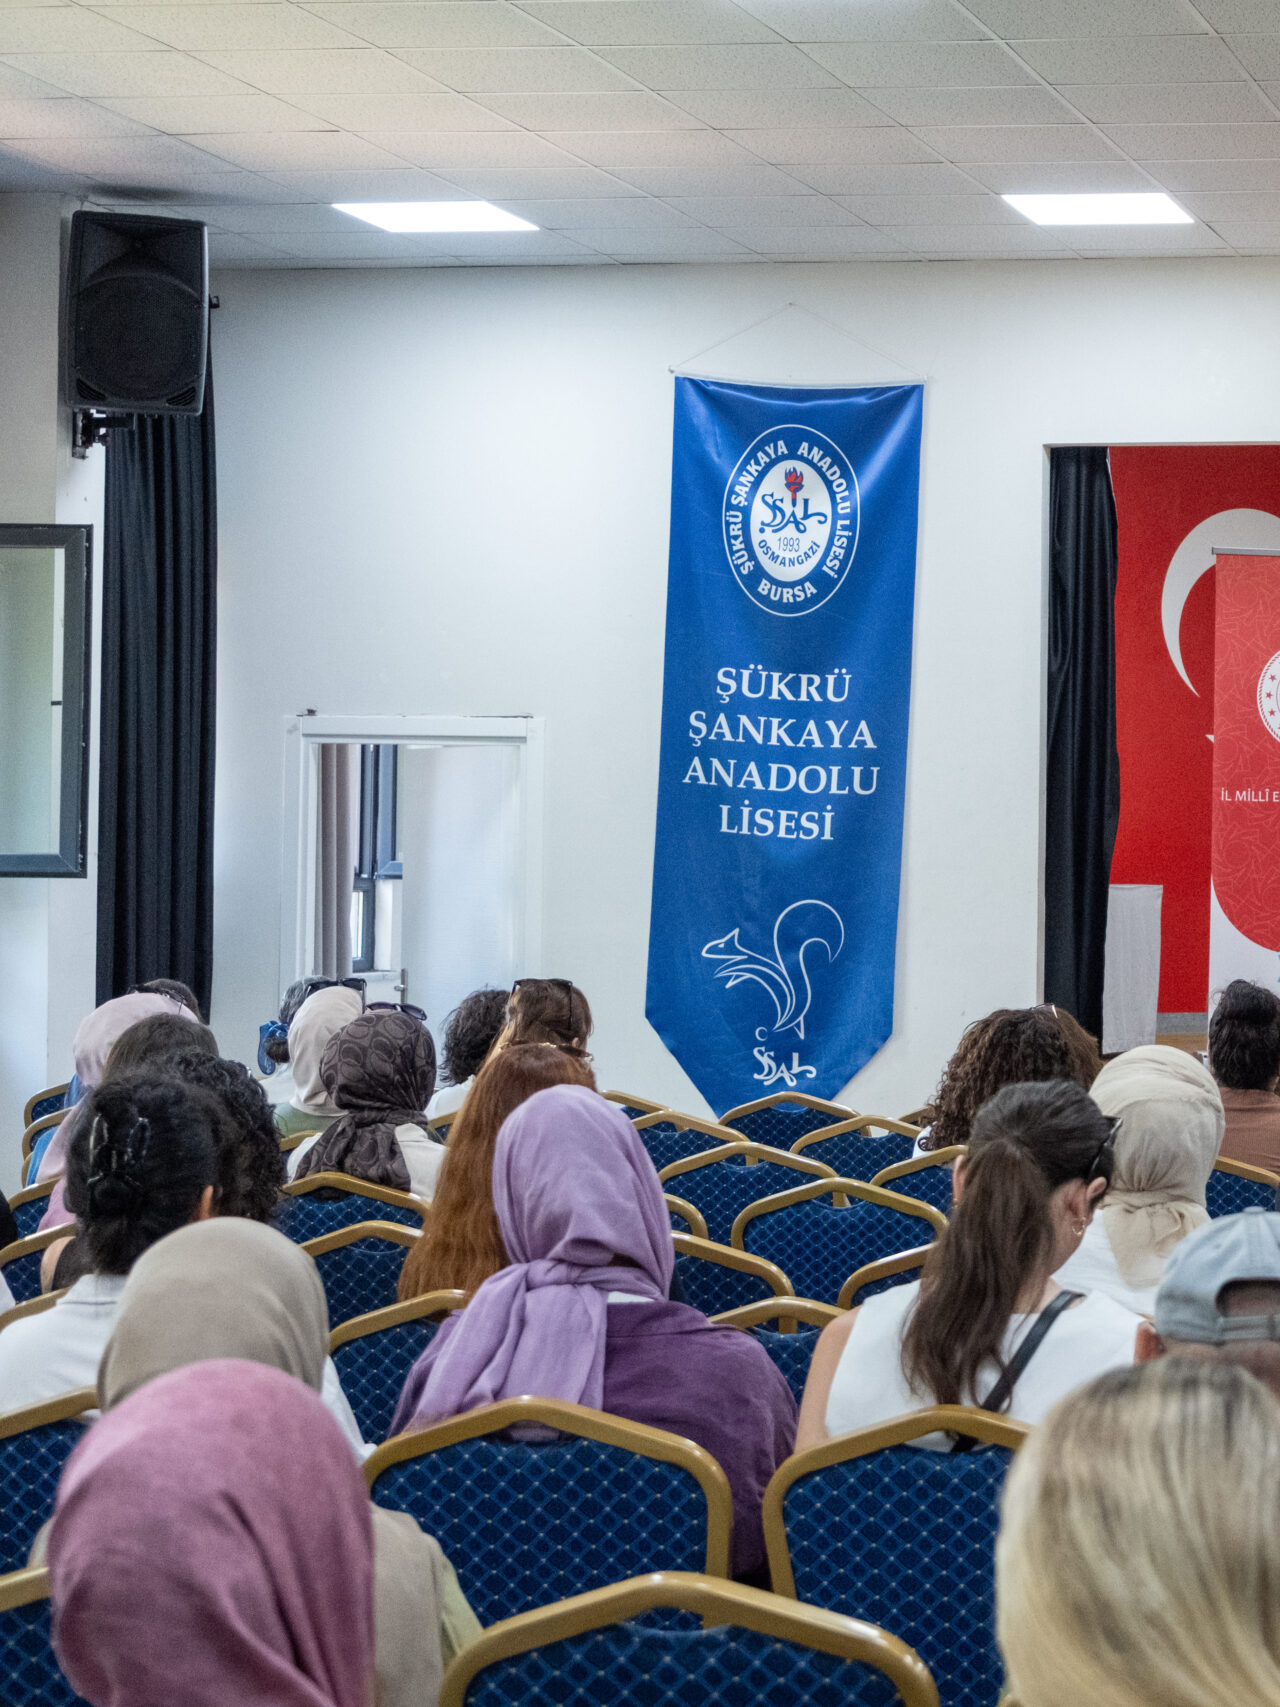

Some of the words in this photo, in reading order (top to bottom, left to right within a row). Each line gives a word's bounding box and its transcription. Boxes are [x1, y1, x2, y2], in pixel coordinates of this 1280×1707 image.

[731, 440, 788, 507] ŞANKAYA
[797, 442, 850, 514] ANADOLU
[726, 510, 755, 575] ŞÜKRÜ
[758, 539, 820, 567] OSMANGAZİ
[778, 537, 800, 552] 1993
[822, 519, 852, 579] LİSESİ
[757, 578, 817, 603] BURSA
[716, 663, 851, 704] ŞÜKRÜ
[689, 710, 877, 747] ŞANKAYA
[682, 756, 880, 795] ANADOLU
[1221, 787, 1232, 801] İL
[719, 799, 835, 841] LİSESİ
